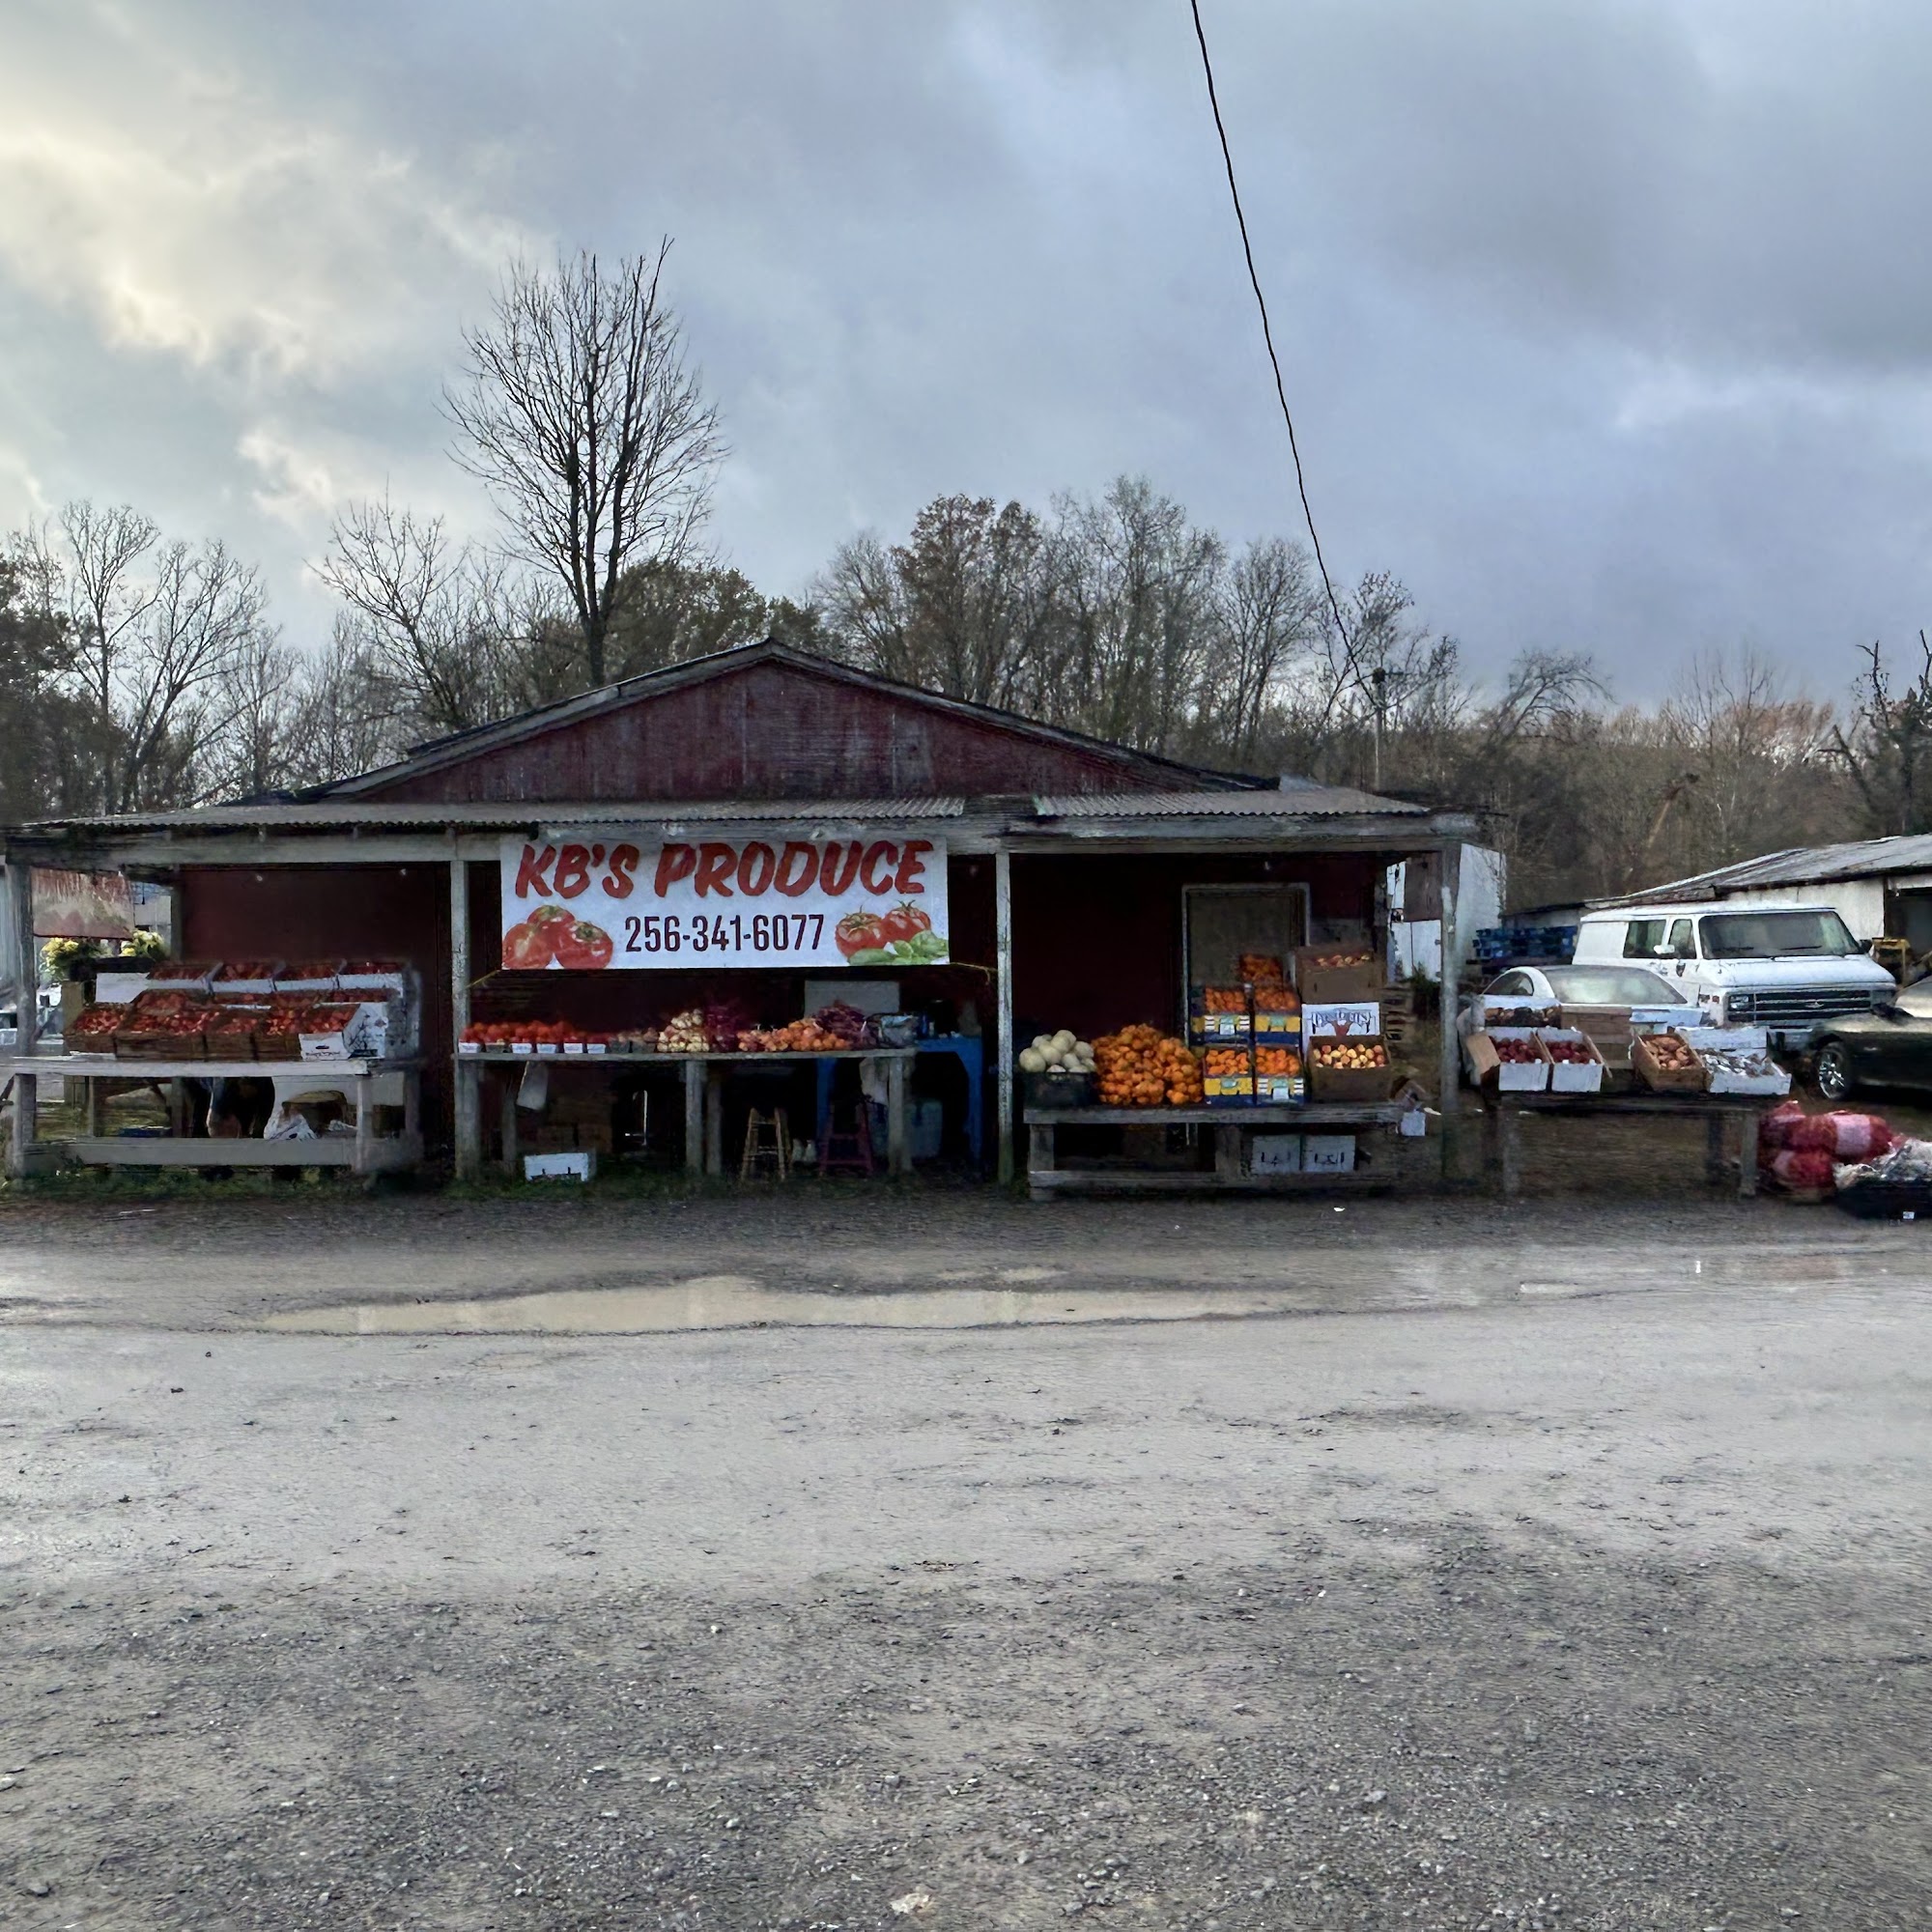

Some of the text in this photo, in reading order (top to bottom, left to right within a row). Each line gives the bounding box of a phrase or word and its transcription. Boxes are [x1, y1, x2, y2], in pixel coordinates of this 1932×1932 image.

[515, 839, 933, 899] KB'S PRODUCE
[625, 914, 824, 952] 256-341-6077
